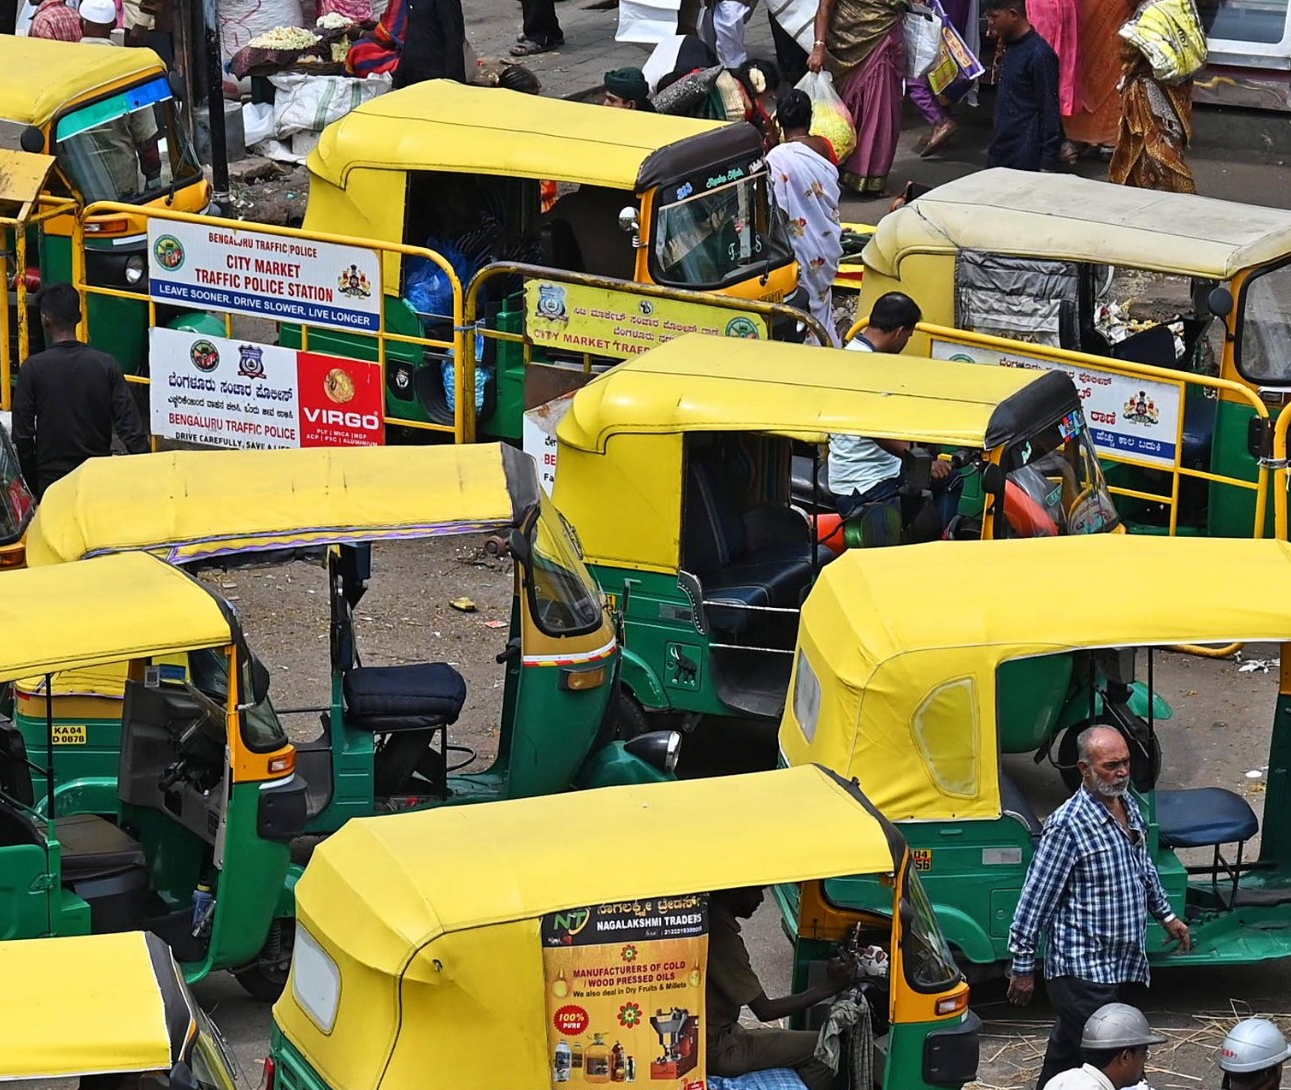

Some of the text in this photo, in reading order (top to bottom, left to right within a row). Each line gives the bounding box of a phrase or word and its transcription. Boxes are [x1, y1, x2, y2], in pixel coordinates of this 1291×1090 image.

[255, 239, 289, 255] TRAFFIC
[289, 244, 318, 259] POLICE
[226, 254, 301, 279] CITY MARKET
[195, 268, 333, 303] TRAFFIC POLICE STATION
[159, 283, 189, 297] LEAVE
[233, 295, 263, 309] DRIVE
[308, 307, 329, 320] LIVE
[330, 311, 370, 326] LONGER
[532, 328, 611, 351] CITY MARKET
[168, 372, 216, 391] ಬೆಂಗಳೂರು
[220, 380, 252, 396] ಸಂಚಾರ
[168, 411, 296, 441] BENGALURU TRAFFIC POLICE
[302, 406, 380, 431] VIRGO
[175, 431, 198, 443] DRIVE
[54, 727, 82, 735] KA 04
[596, 913, 703, 932] NAGALAKSHMI TRADERS
[573, 960, 687, 979] MANUFACTURERS OF COLD
[588, 977, 615, 988] WOOD
[616, 974, 654, 987] PRESSED
[655, 971, 676, 982] OILS
[572, 990, 585, 998] We
[585, 989, 601, 998] also
[602, 988, 617, 997] deal
[617, 987, 625, 996] in
[625, 986, 637, 997] Dry
[638, 984, 658, 994] Fruits
[659, 983, 665, 992] &
[558, 1011, 586, 1023] 100%
[562, 1021, 582, 1030] PURE
